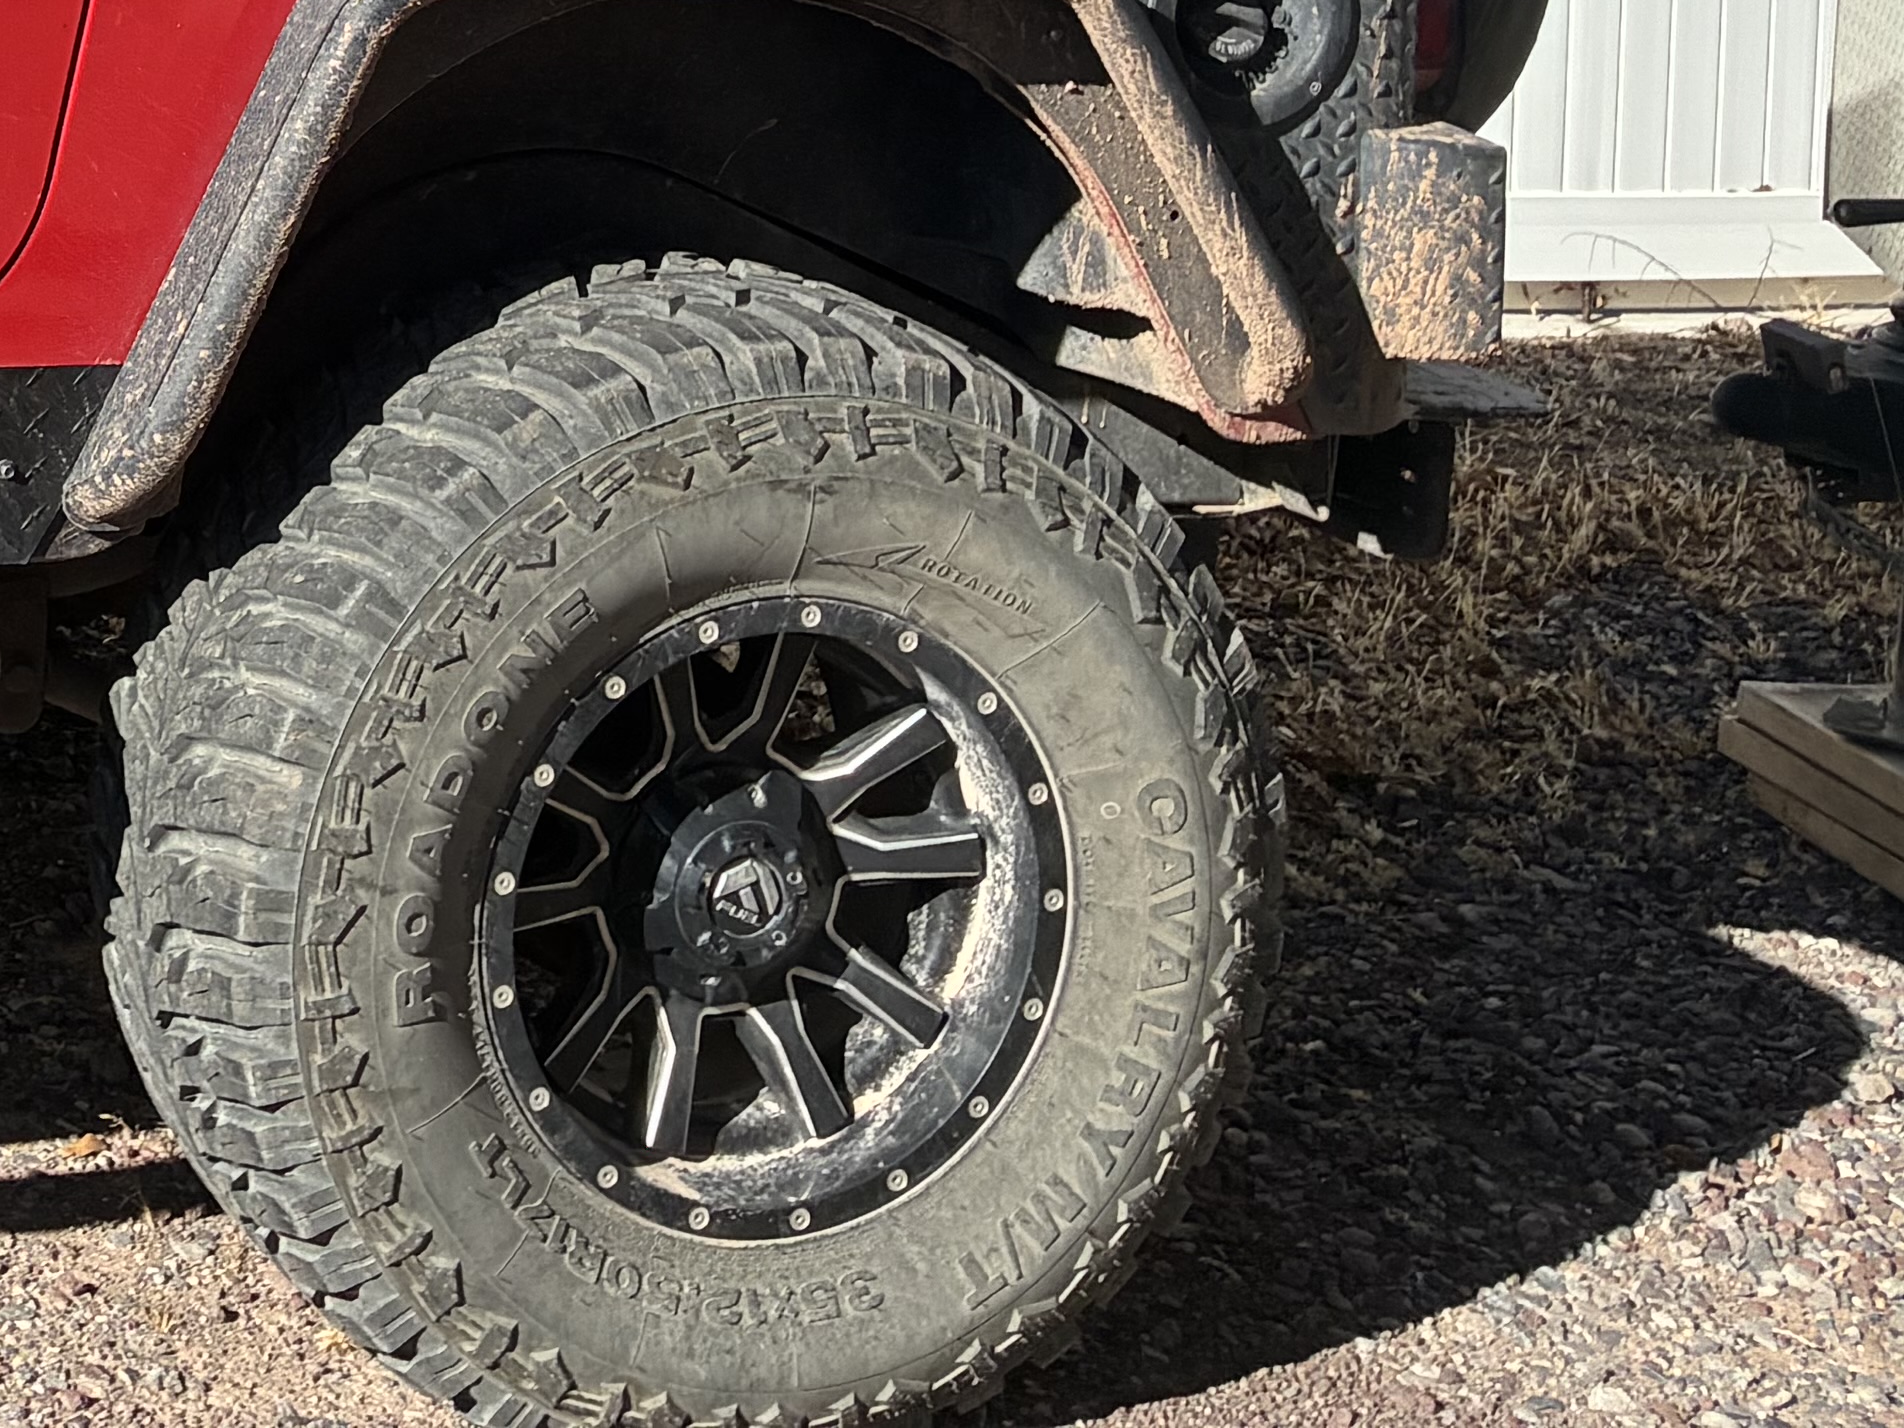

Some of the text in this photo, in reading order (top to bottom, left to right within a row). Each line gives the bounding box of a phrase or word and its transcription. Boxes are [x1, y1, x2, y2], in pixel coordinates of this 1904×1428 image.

[920, 557, 1033, 615] ROTATION
[394, 587, 599, 1028] ROADONE
[1078, 777, 1195, 1177] CAVALRY
